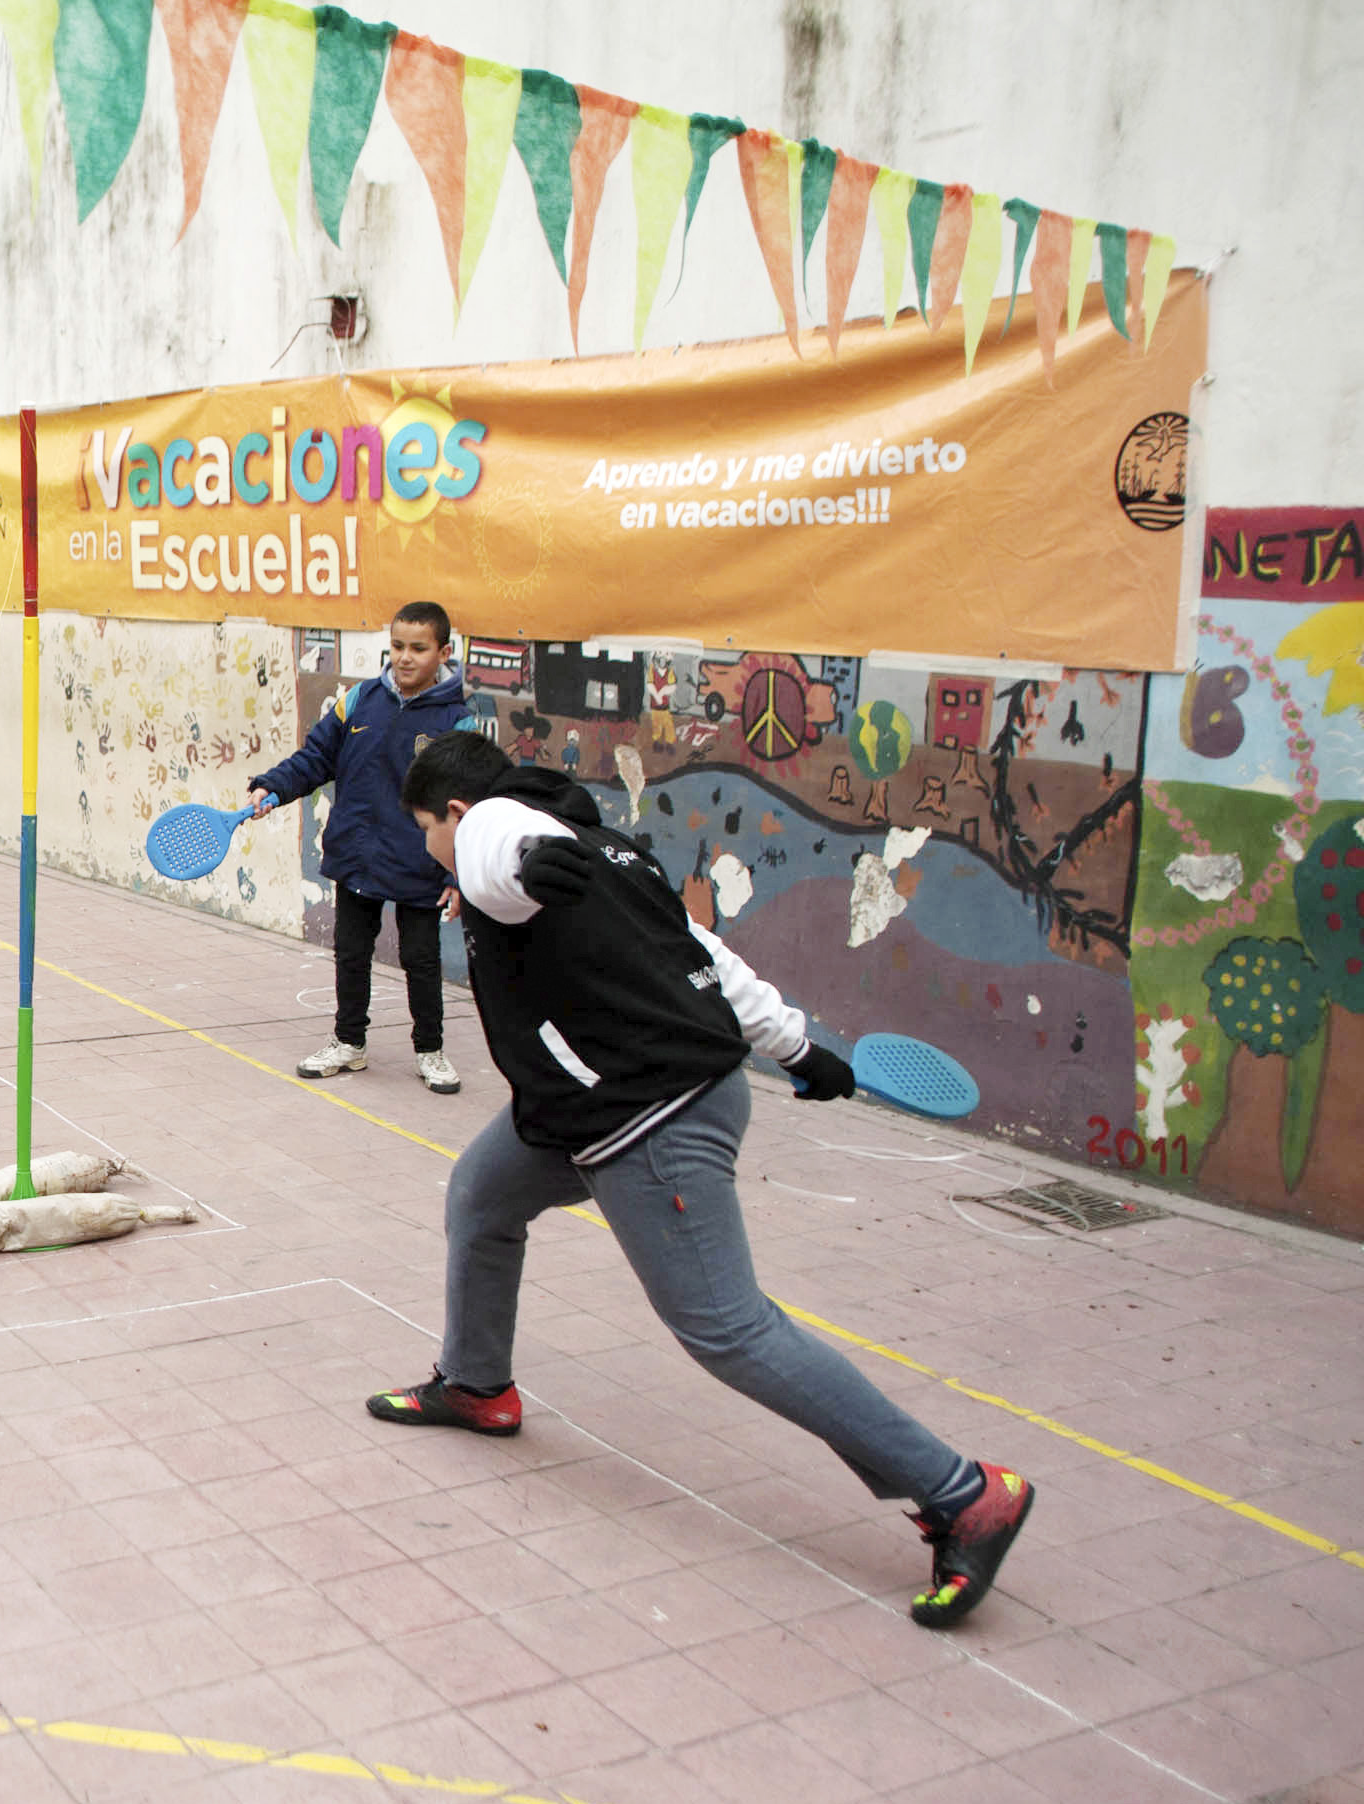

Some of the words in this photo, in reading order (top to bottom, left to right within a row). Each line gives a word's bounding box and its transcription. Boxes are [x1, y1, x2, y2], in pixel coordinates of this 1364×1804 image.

[583, 452, 719, 494] Aprendo
[721, 454, 748, 490] y
[750, 453, 805, 482] me
[812, 437, 967, 479] divierto
[620, 499, 656, 529] en
[665, 487, 892, 528] vacaciones!!!
[69, 529, 99, 561] en
[102, 519, 123, 561] la
[130, 513, 361, 597] Escuela!
[1203, 520, 1364, 586] NETA
[1087, 1114, 1189, 1177] 2011
